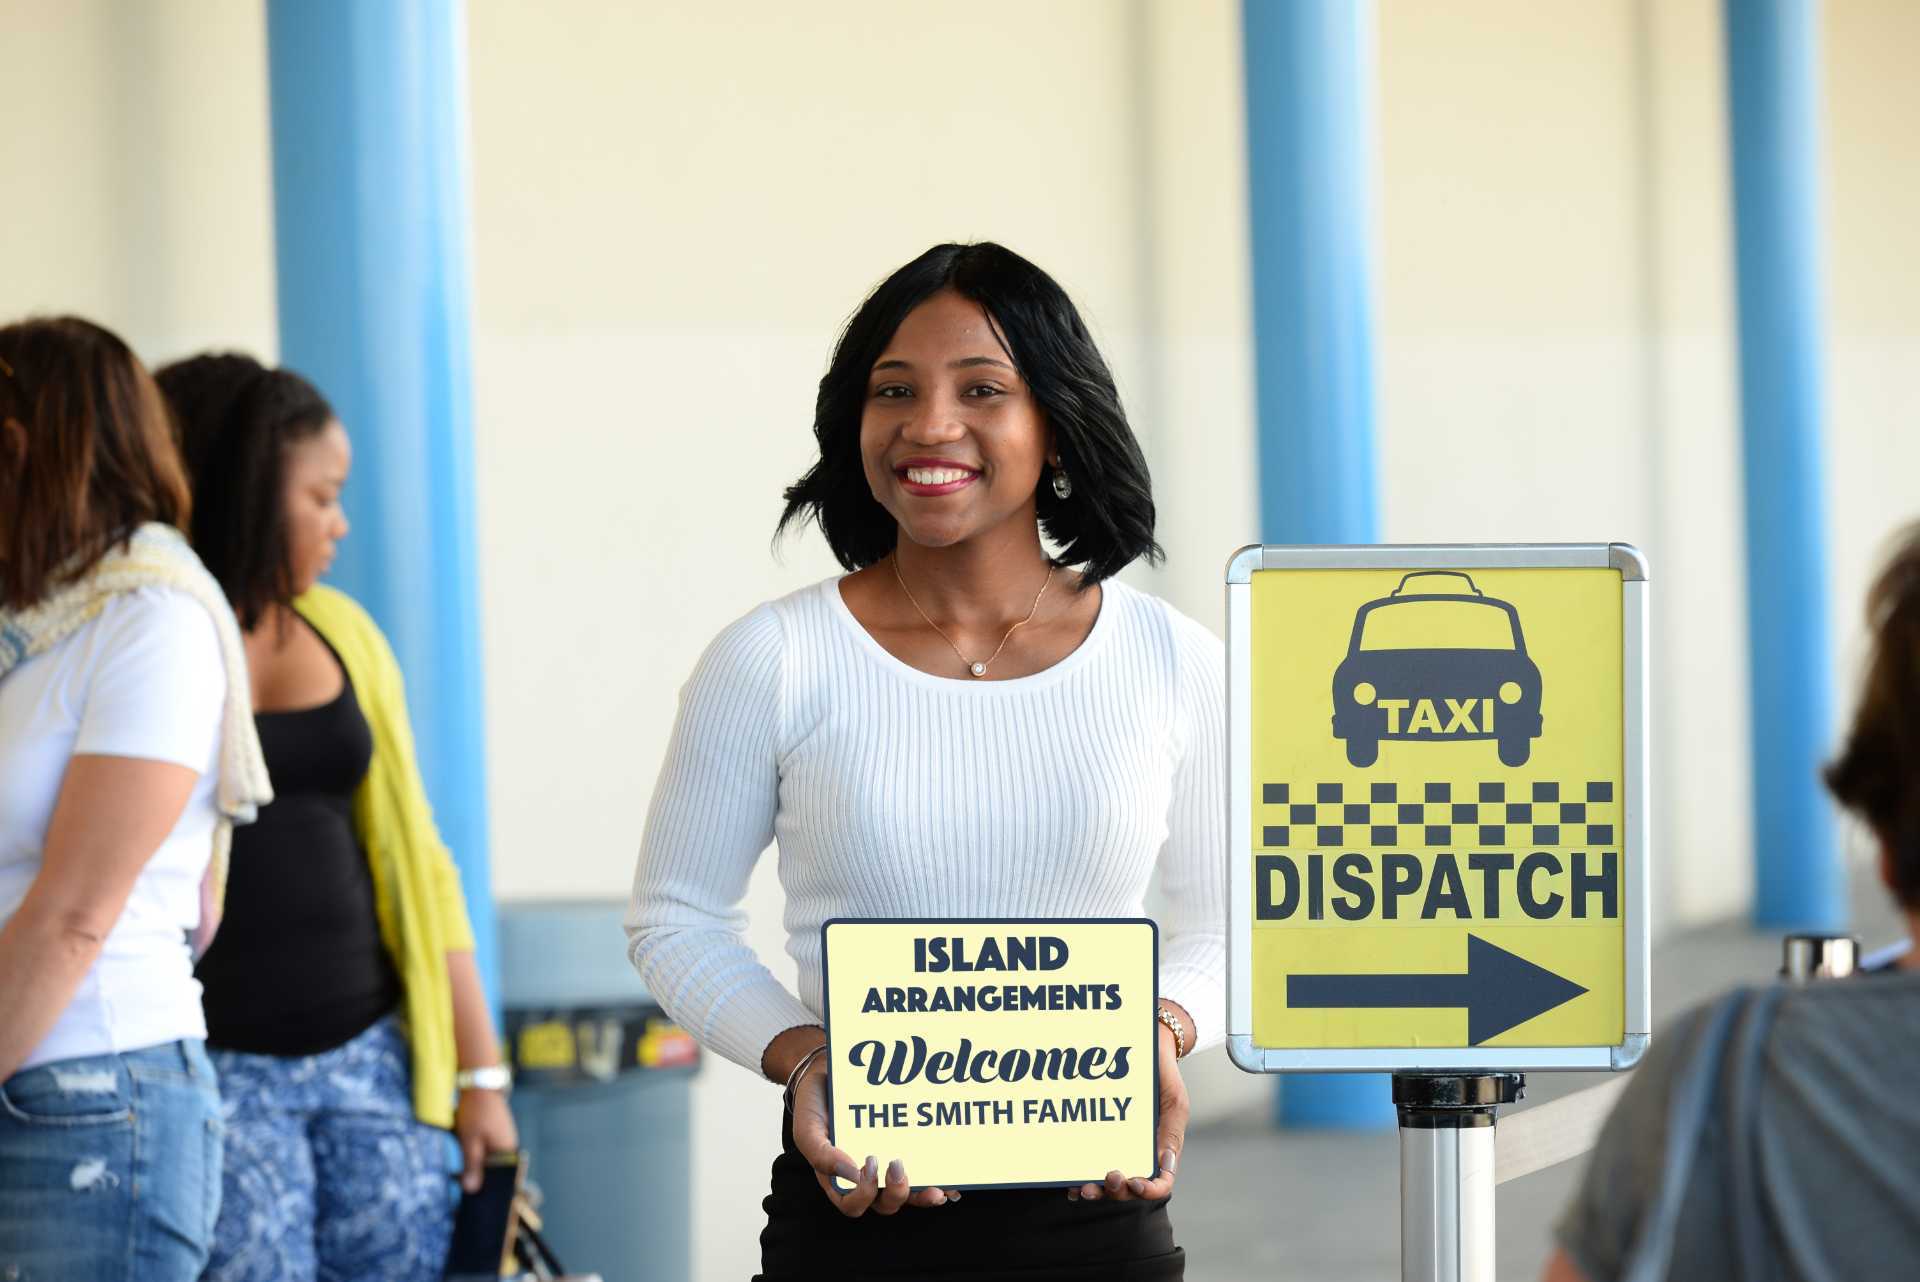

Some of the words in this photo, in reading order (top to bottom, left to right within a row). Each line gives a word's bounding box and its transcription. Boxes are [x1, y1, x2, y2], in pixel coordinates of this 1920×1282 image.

[1377, 698, 1494, 734] TAXI
[1255, 851, 1618, 921] DISPATCH
[913, 936, 1069, 973] ISLAND
[861, 983, 1122, 1013] ARRANGEMENTS
[848, 1035, 1132, 1086] Welcomes
[848, 1103, 908, 1129] THE
[917, 1099, 1013, 1127] SMITH
[1023, 1096, 1132, 1124] FAMILY
